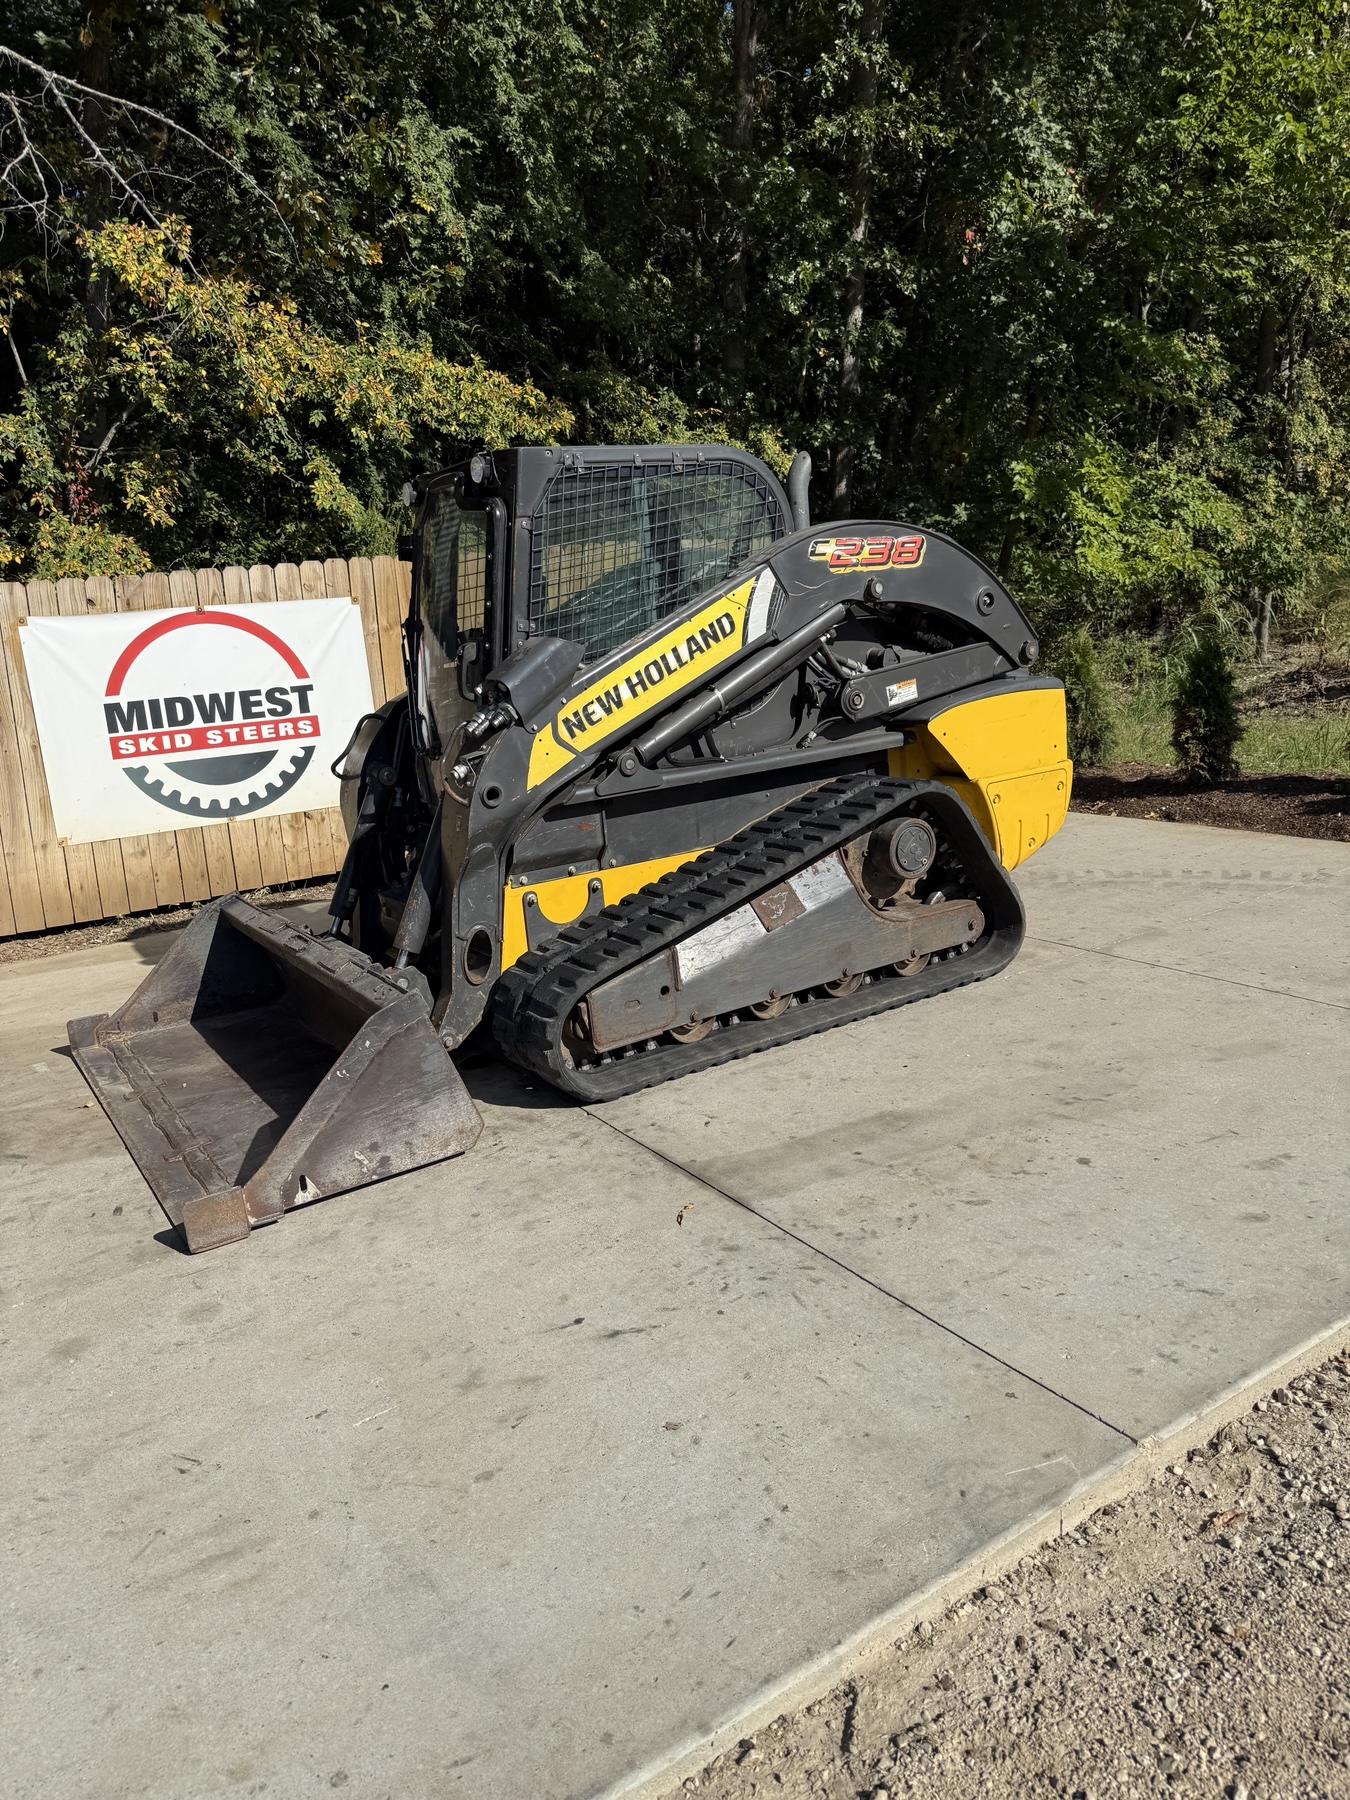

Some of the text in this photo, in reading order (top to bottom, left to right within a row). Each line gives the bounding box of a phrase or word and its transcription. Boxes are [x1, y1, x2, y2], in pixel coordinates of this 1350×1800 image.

[561, 611, 737, 740] NEW HOLLAND
[103, 684, 314, 734] MIDWEST
[118, 719, 314, 755] SKID STEERS
